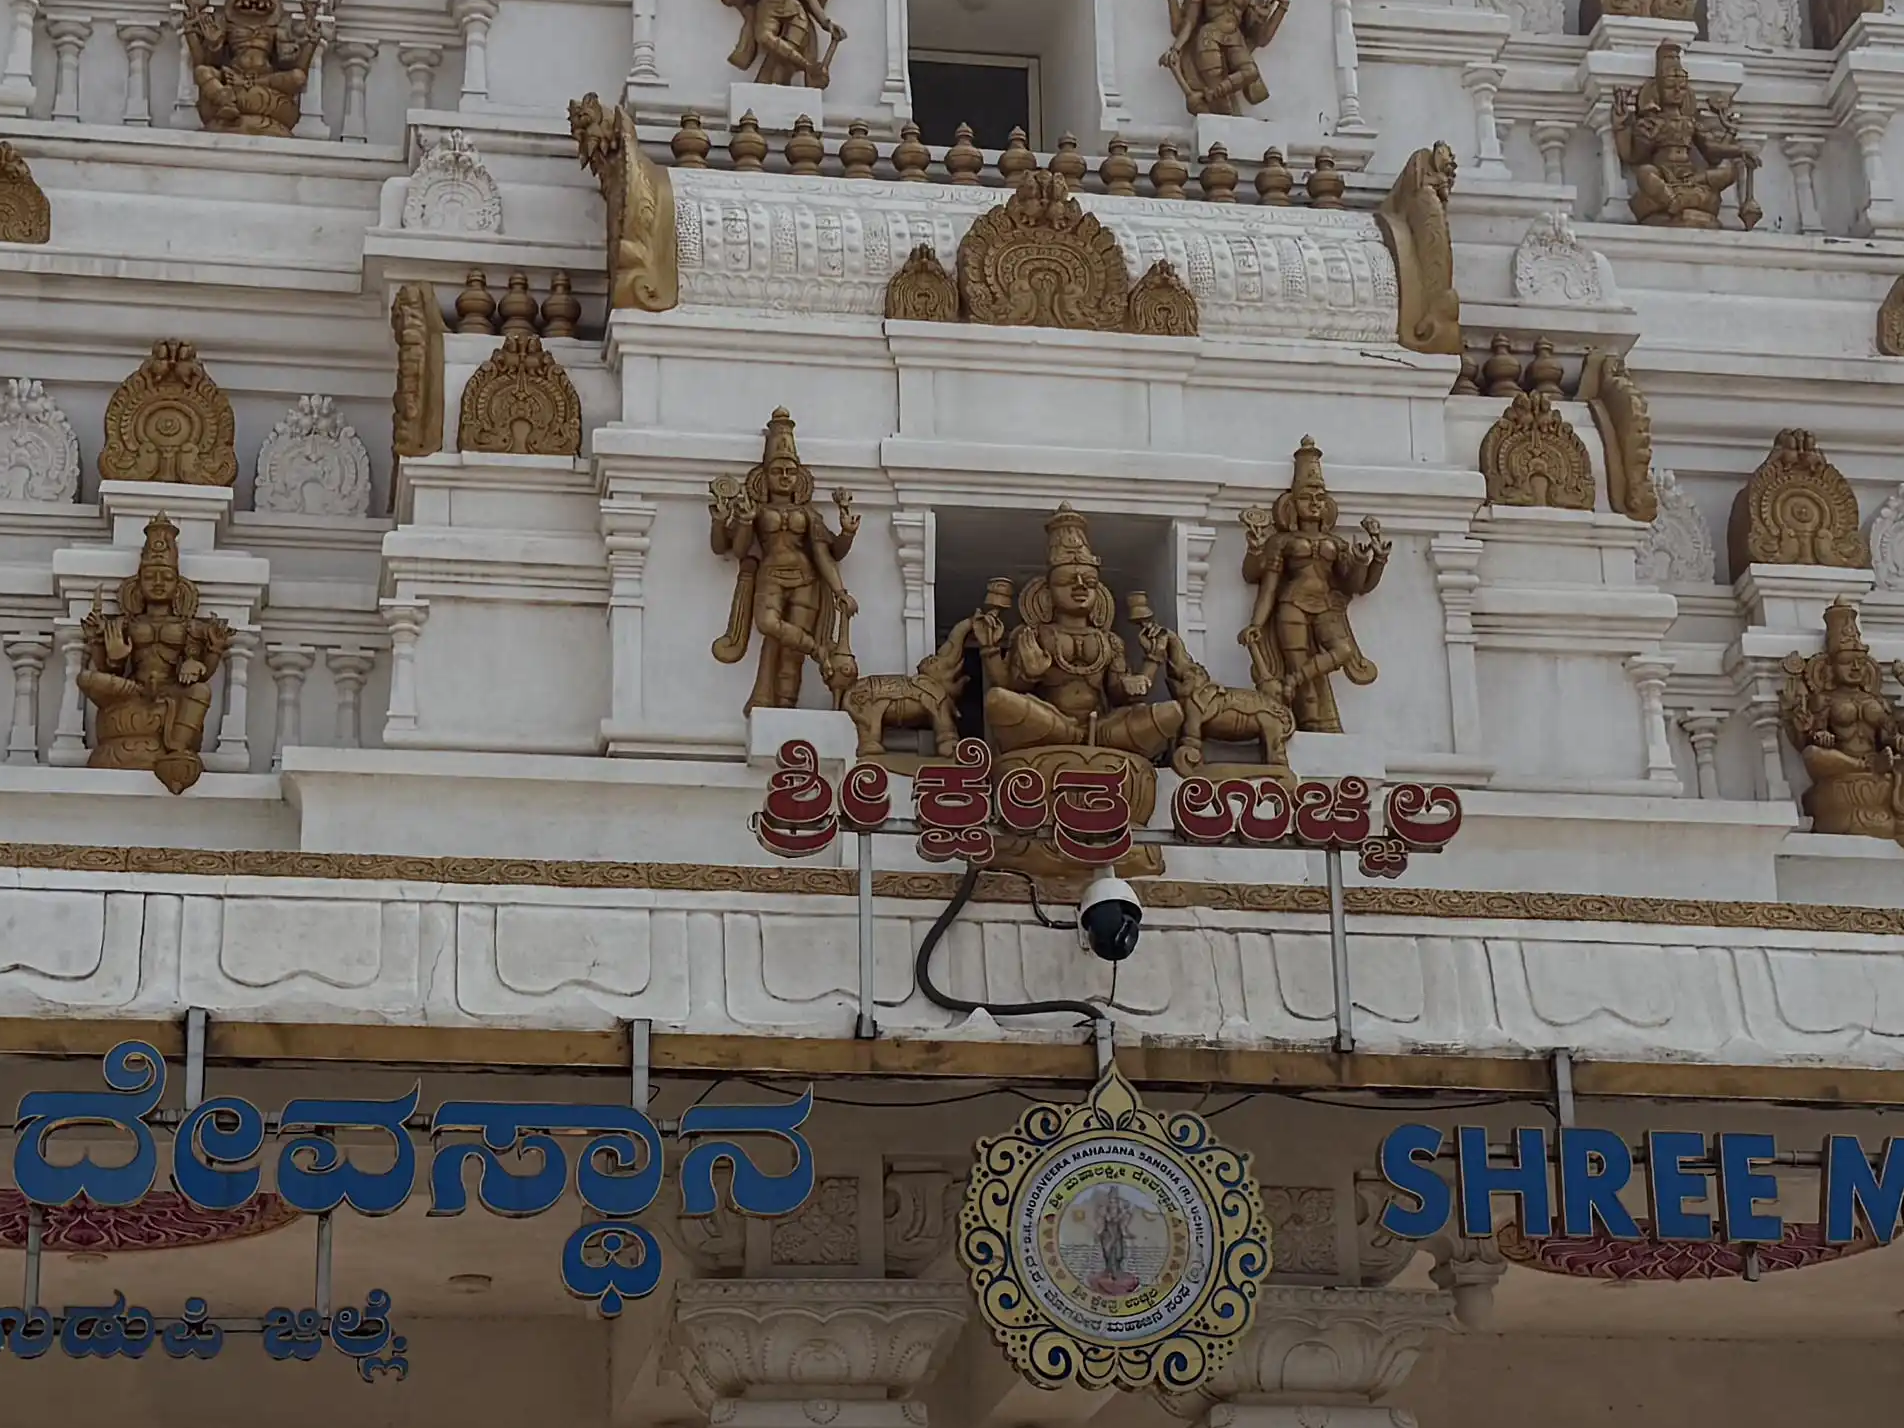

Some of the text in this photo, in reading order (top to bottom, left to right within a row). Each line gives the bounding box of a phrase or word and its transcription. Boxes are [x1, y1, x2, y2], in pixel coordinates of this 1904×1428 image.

[747, 737, 1464, 879] ಶ್ರೀ ಕ್ಷೇತ್ರ ಉಚ್ಚಿಲ
[12, 1038, 817, 1317] ದೇವಸ್ಥಾನ
[1071, 1145, 1135, 1162] MAHAJANA
[1376, 1122, 1787, 1245] SHREE
[262, 1287, 410, 1384] ಜಿಲ್ಲೆ
